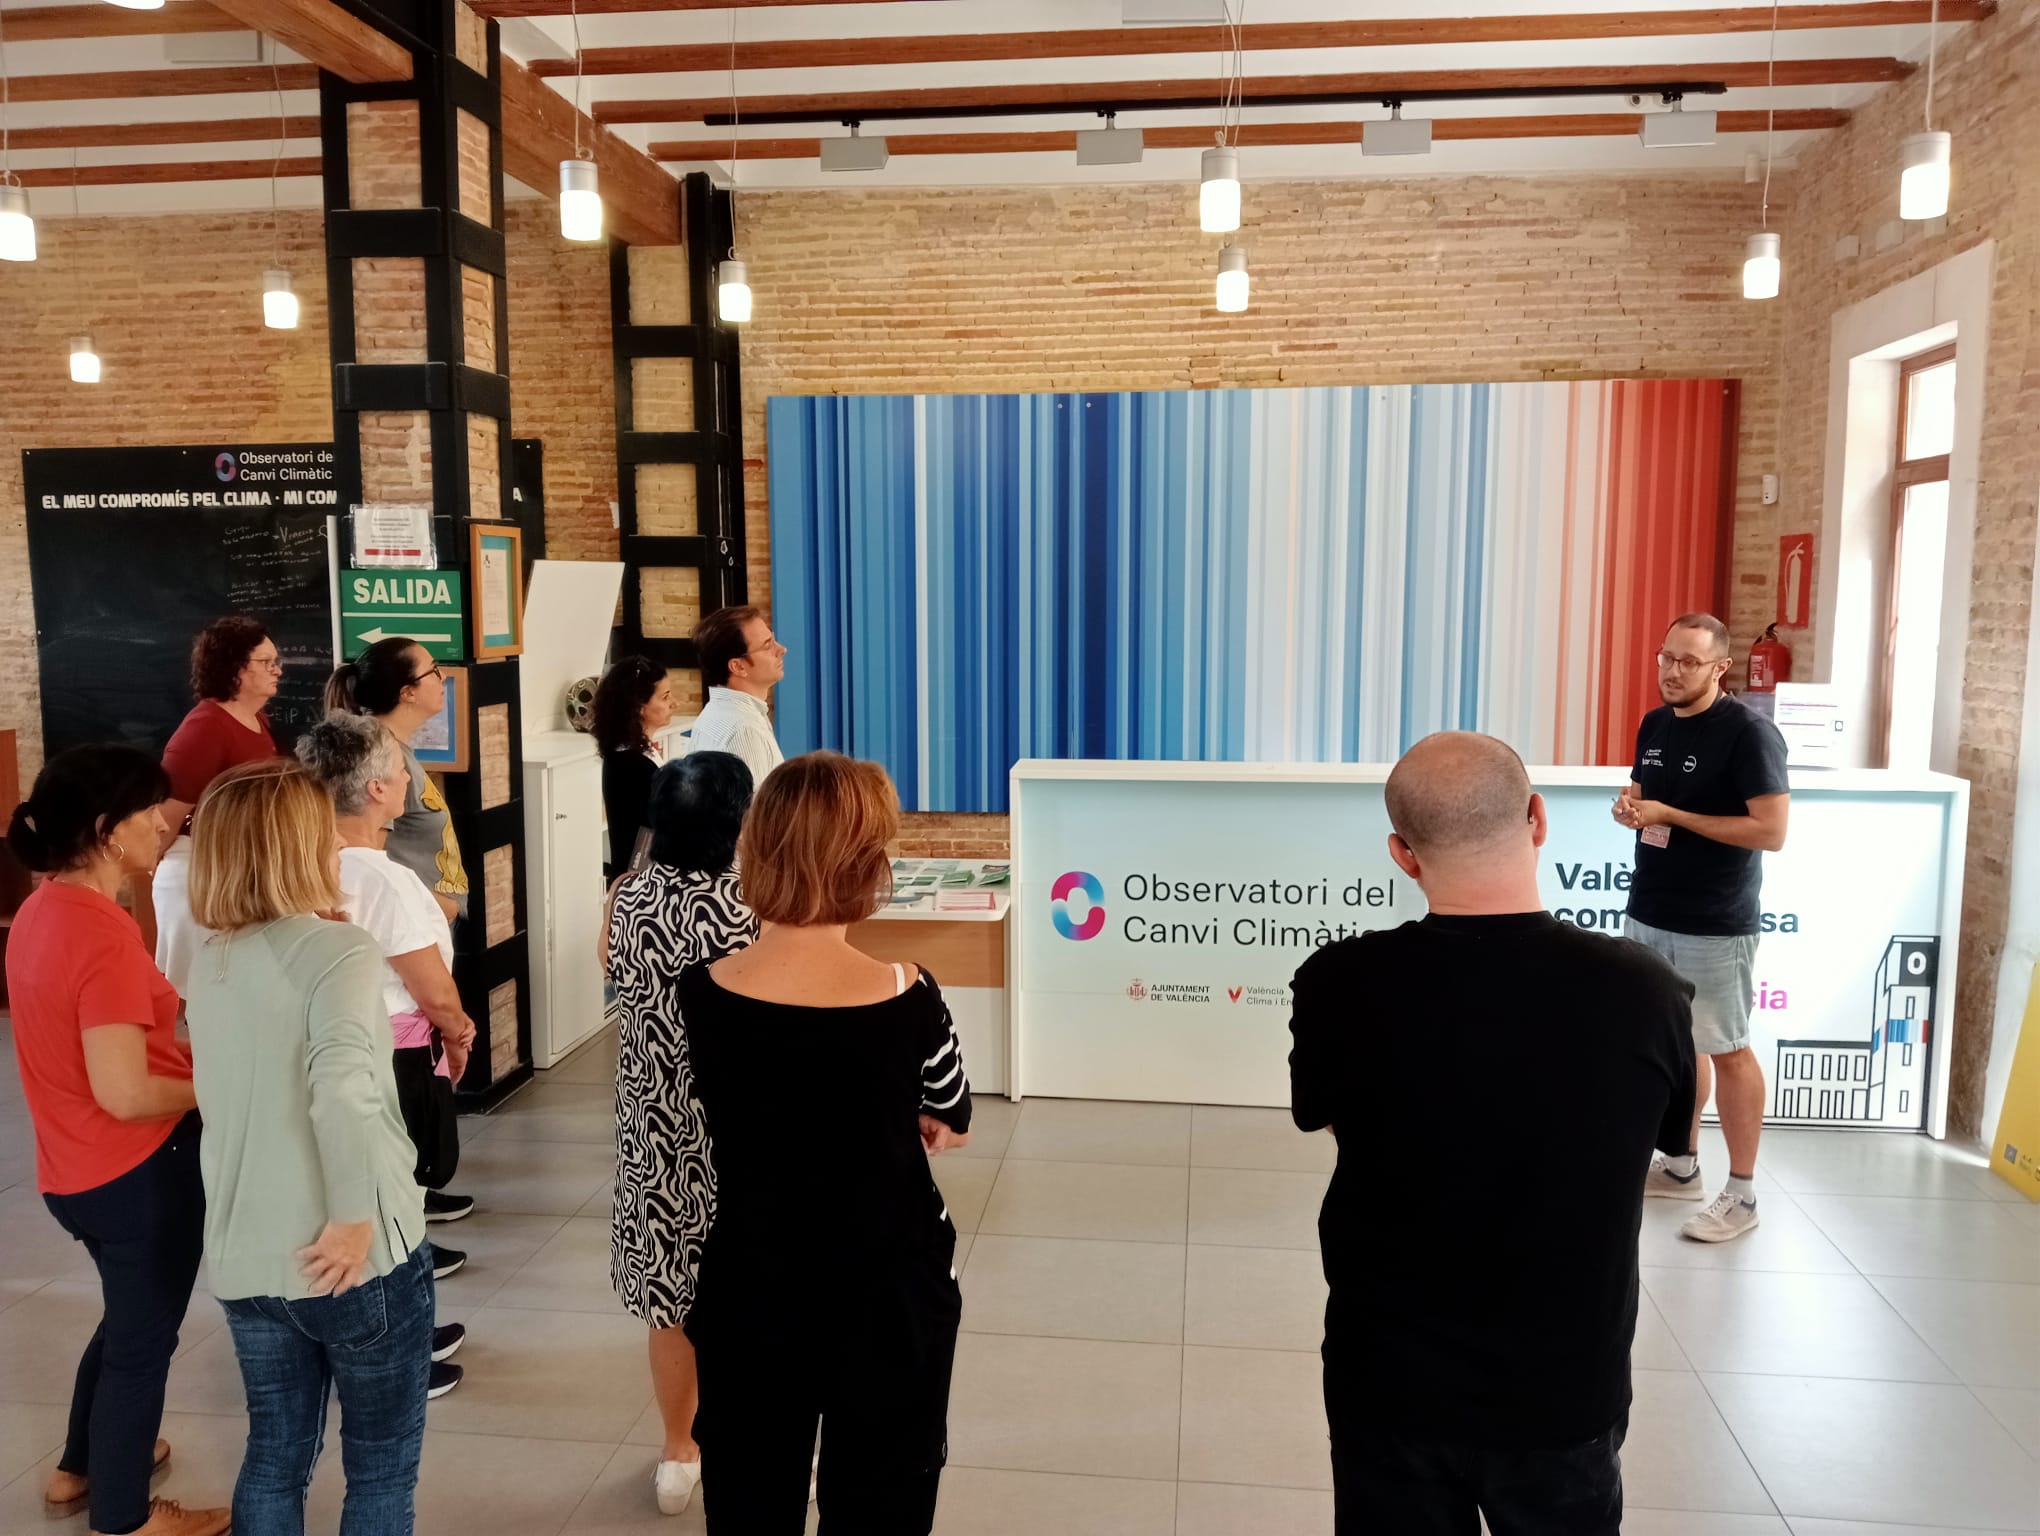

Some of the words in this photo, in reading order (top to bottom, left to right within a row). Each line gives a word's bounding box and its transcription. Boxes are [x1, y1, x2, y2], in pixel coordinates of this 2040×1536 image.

[239, 451, 314, 464] Observatori
[317, 450, 334, 463] de
[240, 468, 276, 481] Canvi
[280, 467, 333, 480] Climàtic
[42, 495, 61, 509] EL
[63, 494, 96, 509] MEU
[99, 489, 189, 508] COMPROMÍS
[192, 492, 221, 507] PEL
[223, 491, 273, 506] CLIMA
[283, 490, 303, 505] MI
[353, 577, 452, 605] SALIDA
[1555, 862, 1635, 891] Valè
[1124, 873, 1328, 906] Observatori
[1343, 877, 1395, 907] del
[1124, 915, 1219, 945] Canvi
[1151, 984, 1211, 994] AJUNTAMENT
[1247, 985, 1285, 996] València
[1151, 993, 1163, 1001] DE
[1166, 992, 1211, 1003] VALÈNCIA
[1246, 997, 1274, 1006] Clima
[1281, 999, 1294, 1007] En
